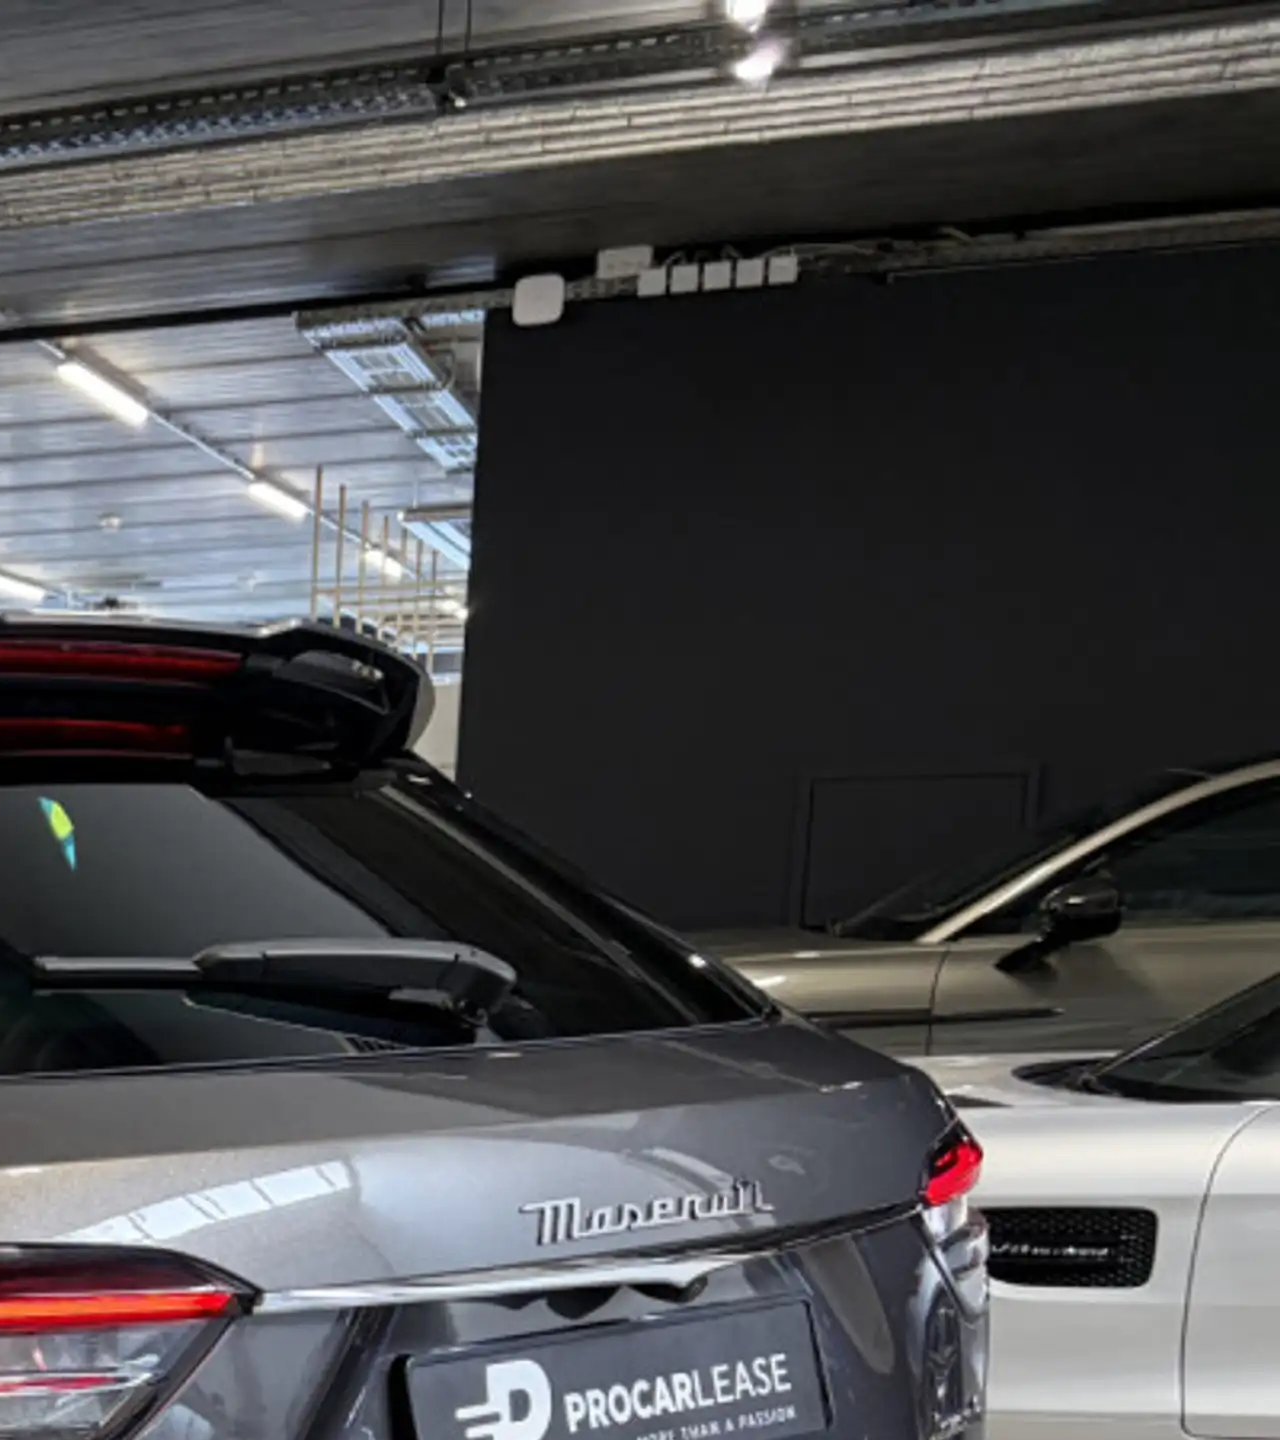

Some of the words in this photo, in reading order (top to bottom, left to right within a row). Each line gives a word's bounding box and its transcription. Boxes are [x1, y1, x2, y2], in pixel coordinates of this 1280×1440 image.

[519, 1178, 776, 1246] Maserati
[564, 1353, 792, 1434] PROCARLEASE
[725, 1417, 736, 1433] A
[738, 1405, 797, 1431] PASSION
